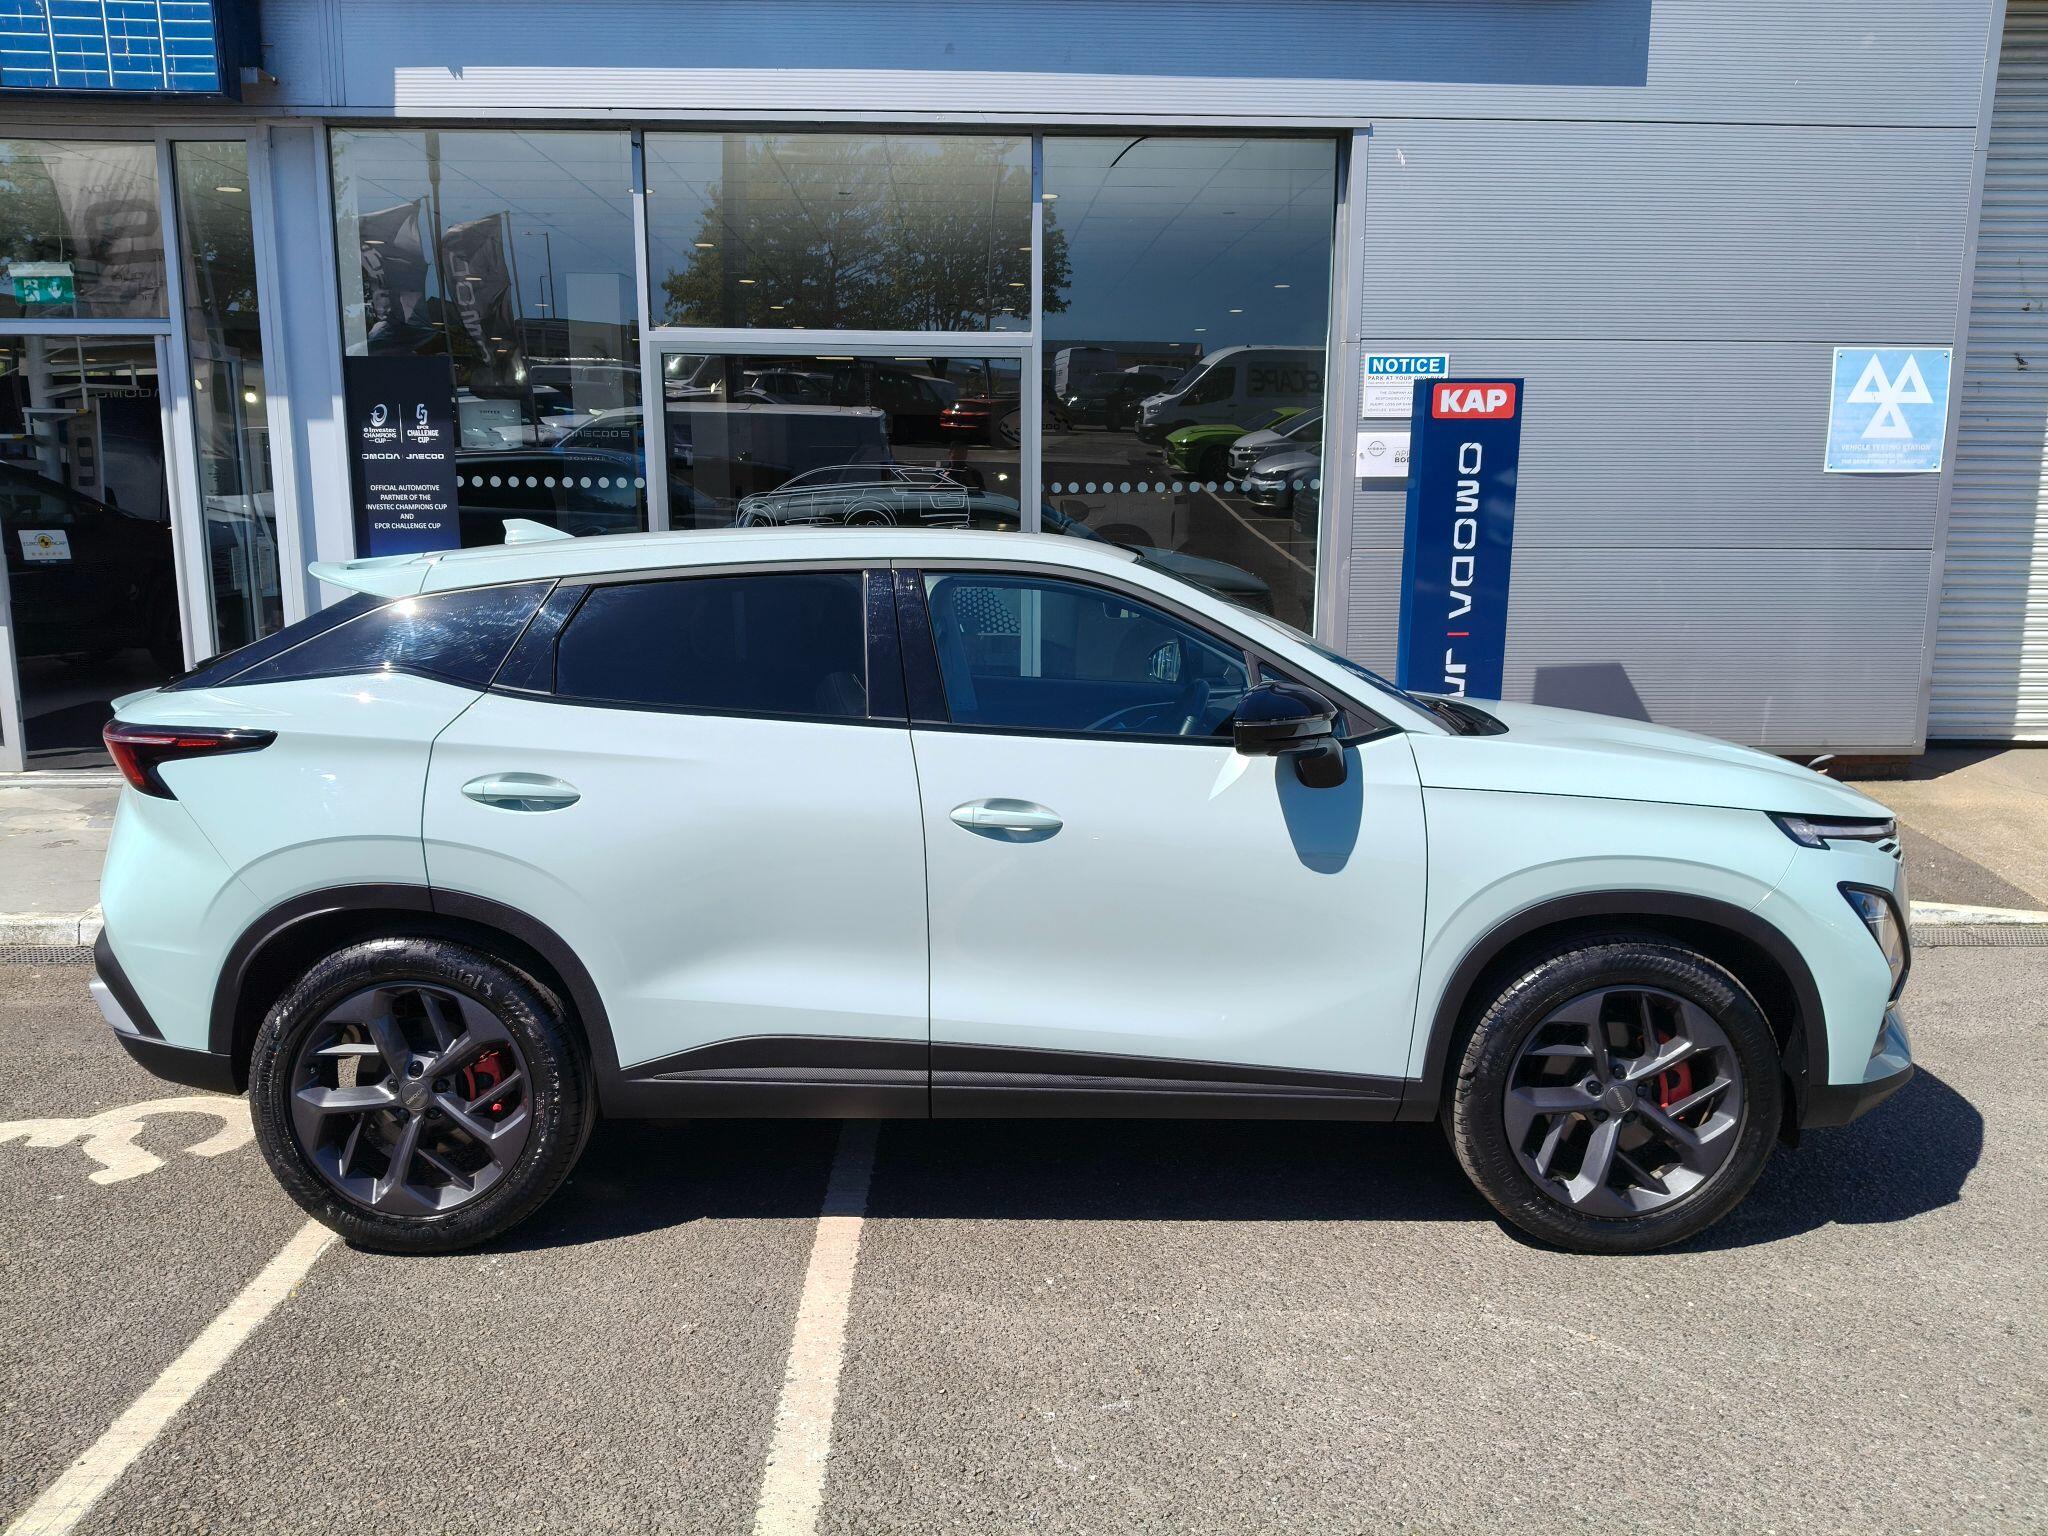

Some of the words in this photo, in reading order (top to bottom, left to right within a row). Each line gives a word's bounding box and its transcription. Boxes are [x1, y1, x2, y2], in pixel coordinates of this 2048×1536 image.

[1372, 358, 1440, 373] NOTICE
[1440, 389, 1508, 413] KAP
[407, 429, 439, 437] CHALLENGE
[417, 436, 430, 444] CUP
[374, 522, 391, 530] EPCR
[391, 522, 427, 530] CHALLENGE
[427, 522, 441, 530] CUP
[1448, 441, 1483, 620] OMODA
